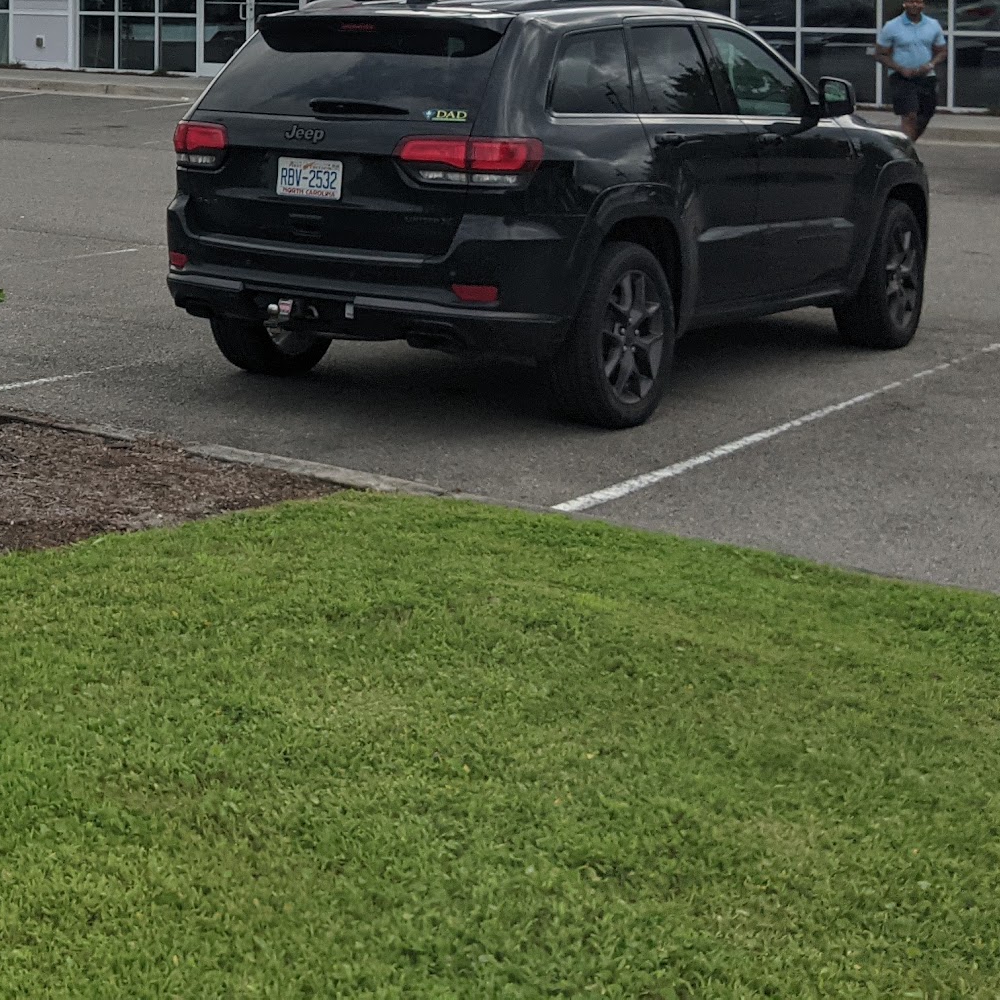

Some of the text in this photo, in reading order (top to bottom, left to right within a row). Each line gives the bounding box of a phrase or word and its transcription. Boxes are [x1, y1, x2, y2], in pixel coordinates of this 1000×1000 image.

[436, 109, 468, 120] DAD
[284, 124, 325, 144] Jeep
[280, 167, 337, 190] RBV-2532
[282, 187, 336, 197] NORTH CAROLINA
